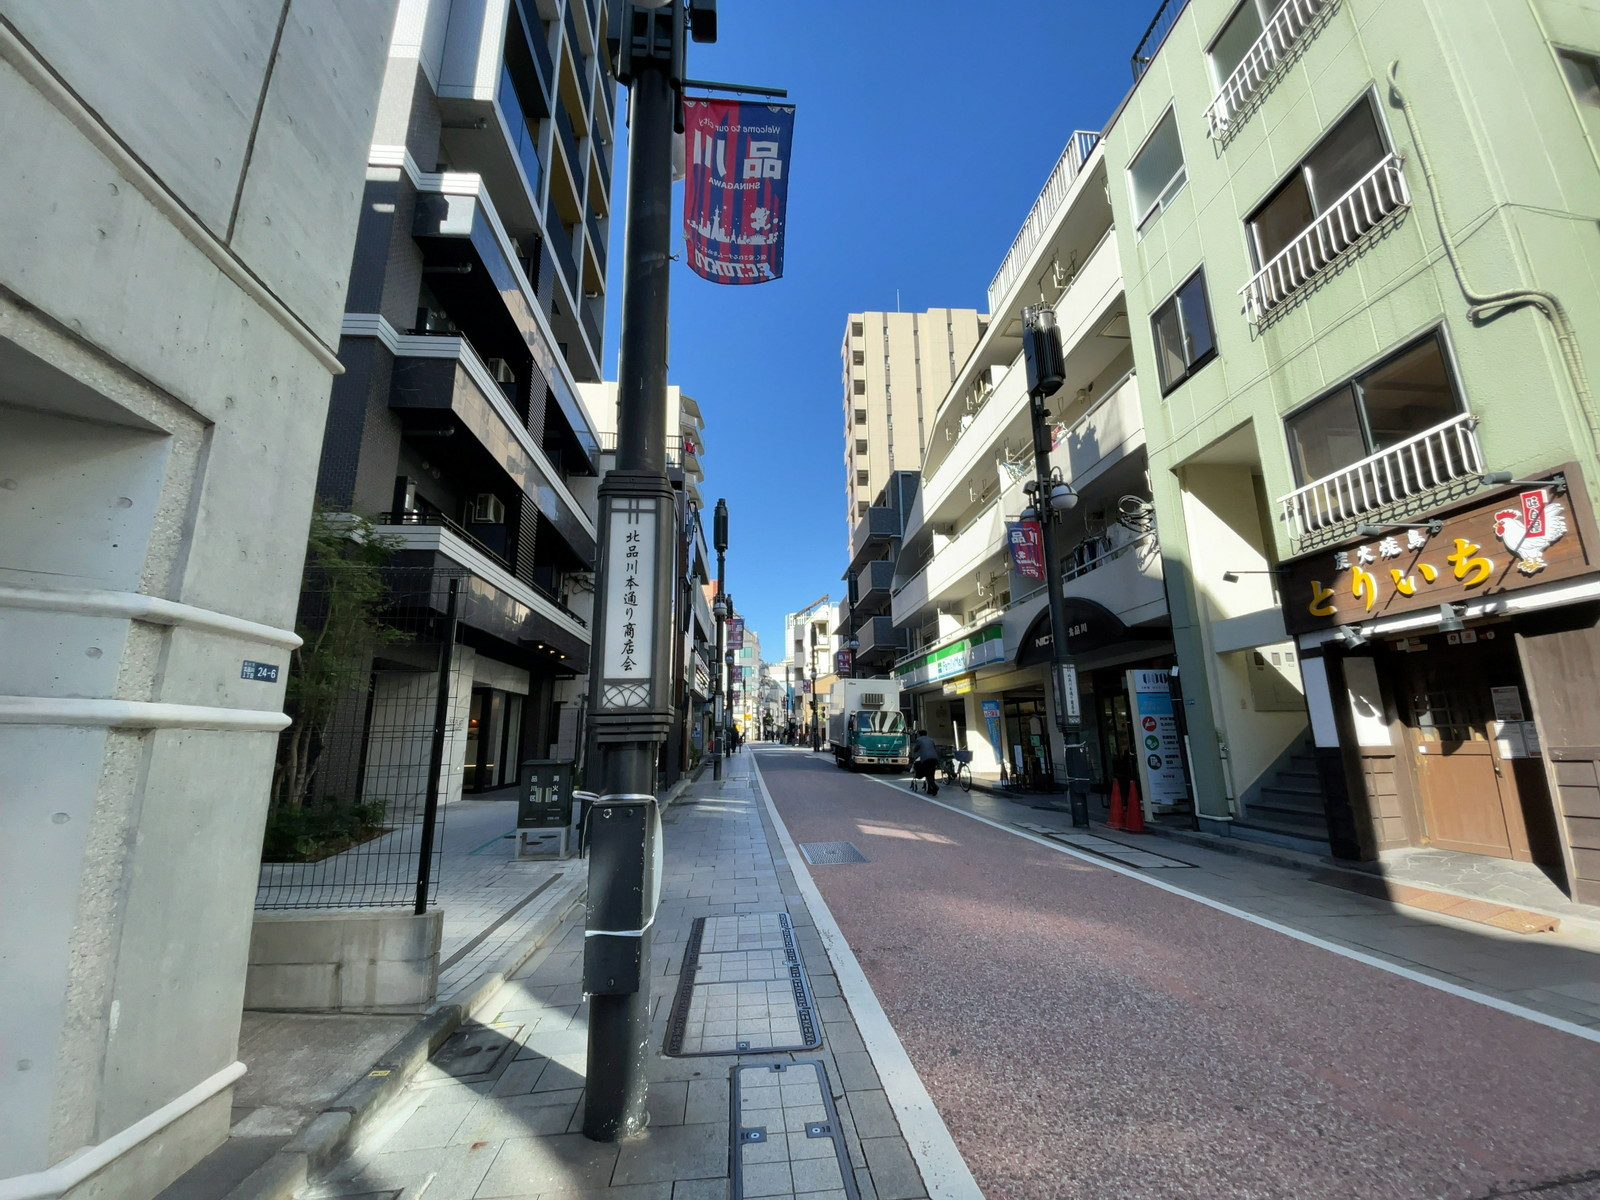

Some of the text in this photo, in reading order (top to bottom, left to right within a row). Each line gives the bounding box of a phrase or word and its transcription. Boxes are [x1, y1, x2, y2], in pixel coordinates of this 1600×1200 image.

[620, 529, 640, 672] 北品川本通り商店会
[1309, 538, 1494, 617] とりいち
[257, 667, 276, 679] 24-6
